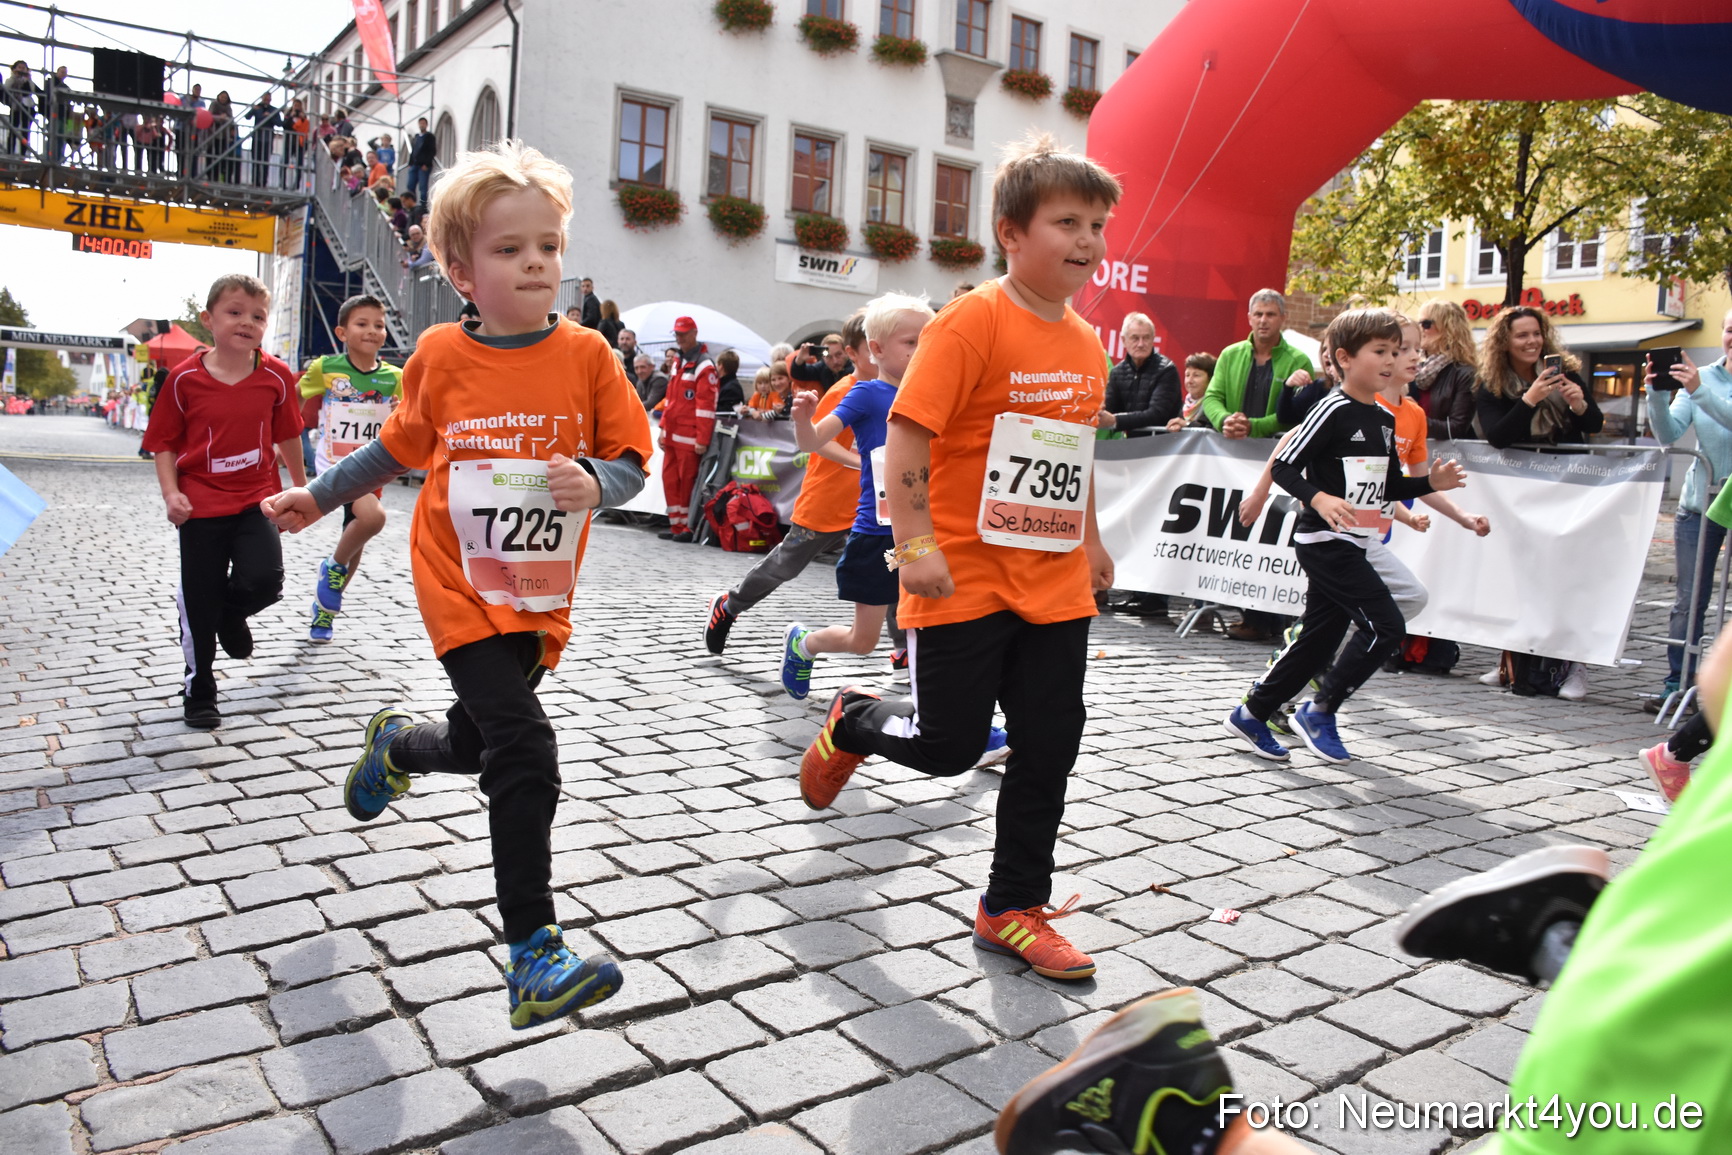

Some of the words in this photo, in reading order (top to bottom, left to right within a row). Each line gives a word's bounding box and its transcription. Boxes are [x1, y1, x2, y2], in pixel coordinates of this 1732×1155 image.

[799, 255, 839, 273] swn
[1092, 258, 1149, 294] ORE
[11, 331, 41, 341] MINI
[43, 334, 113, 347] NEUMARKT.
[1009, 369, 1083, 385] Neumarkter
[1009, 388, 1074, 403] Stadtlauf
[339, 421, 382, 440] 7140
[225, 457, 247, 468] DEHN
[1432, 449, 1462, 461] Energie
[1529, 460, 1561, 473] Freizeit
[1567, 462, 1611, 477] Mobilität
[1008, 455, 1082, 502] 7395
[472, 507, 567, 552] 7225
[987, 503, 1077, 535] Sebastian
[920, 537, 935, 546] KIDS
[1154, 540, 1252, 570] stadtwerke
[501, 566, 549, 591] Simon
[1221, 577, 1266, 600] bieten
